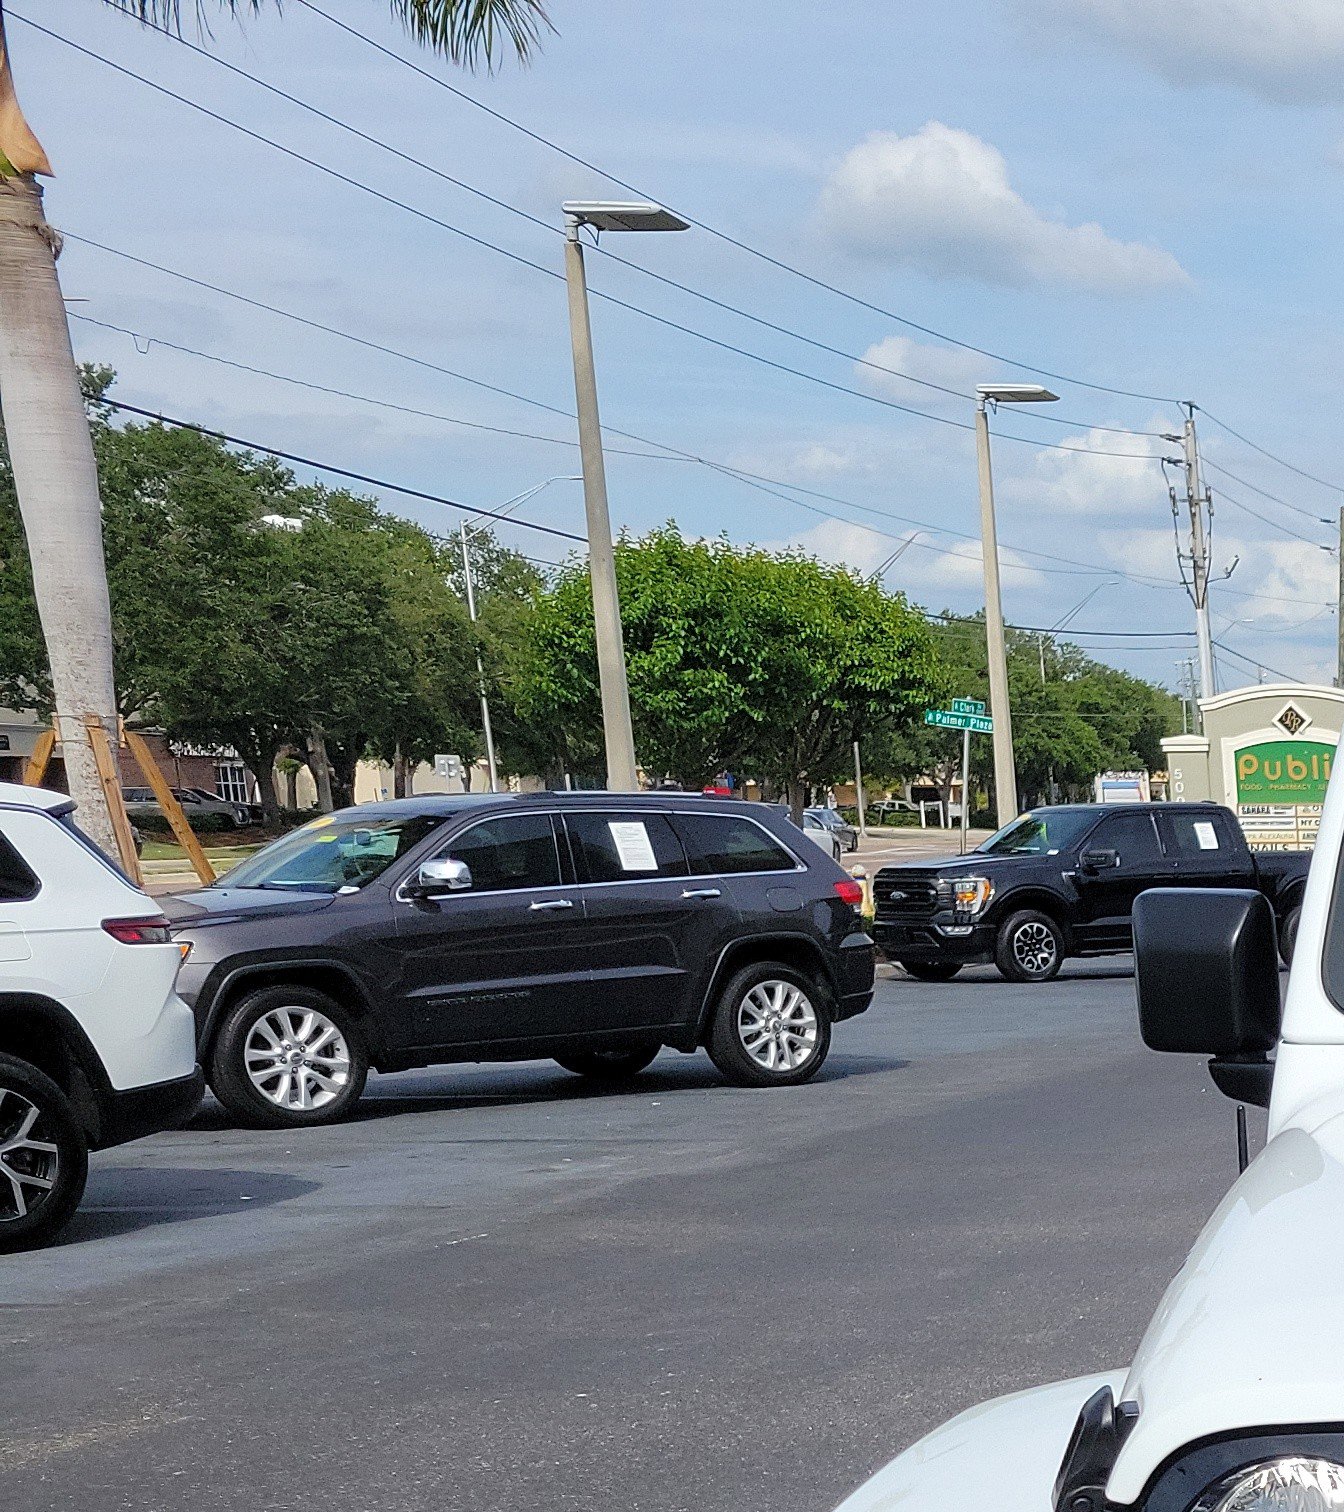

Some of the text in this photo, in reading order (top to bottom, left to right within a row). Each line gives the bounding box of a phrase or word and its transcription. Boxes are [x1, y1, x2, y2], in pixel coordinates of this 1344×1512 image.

[935, 713, 993, 730] Palmer Plaza
[1238, 754, 1330, 780] Publi
